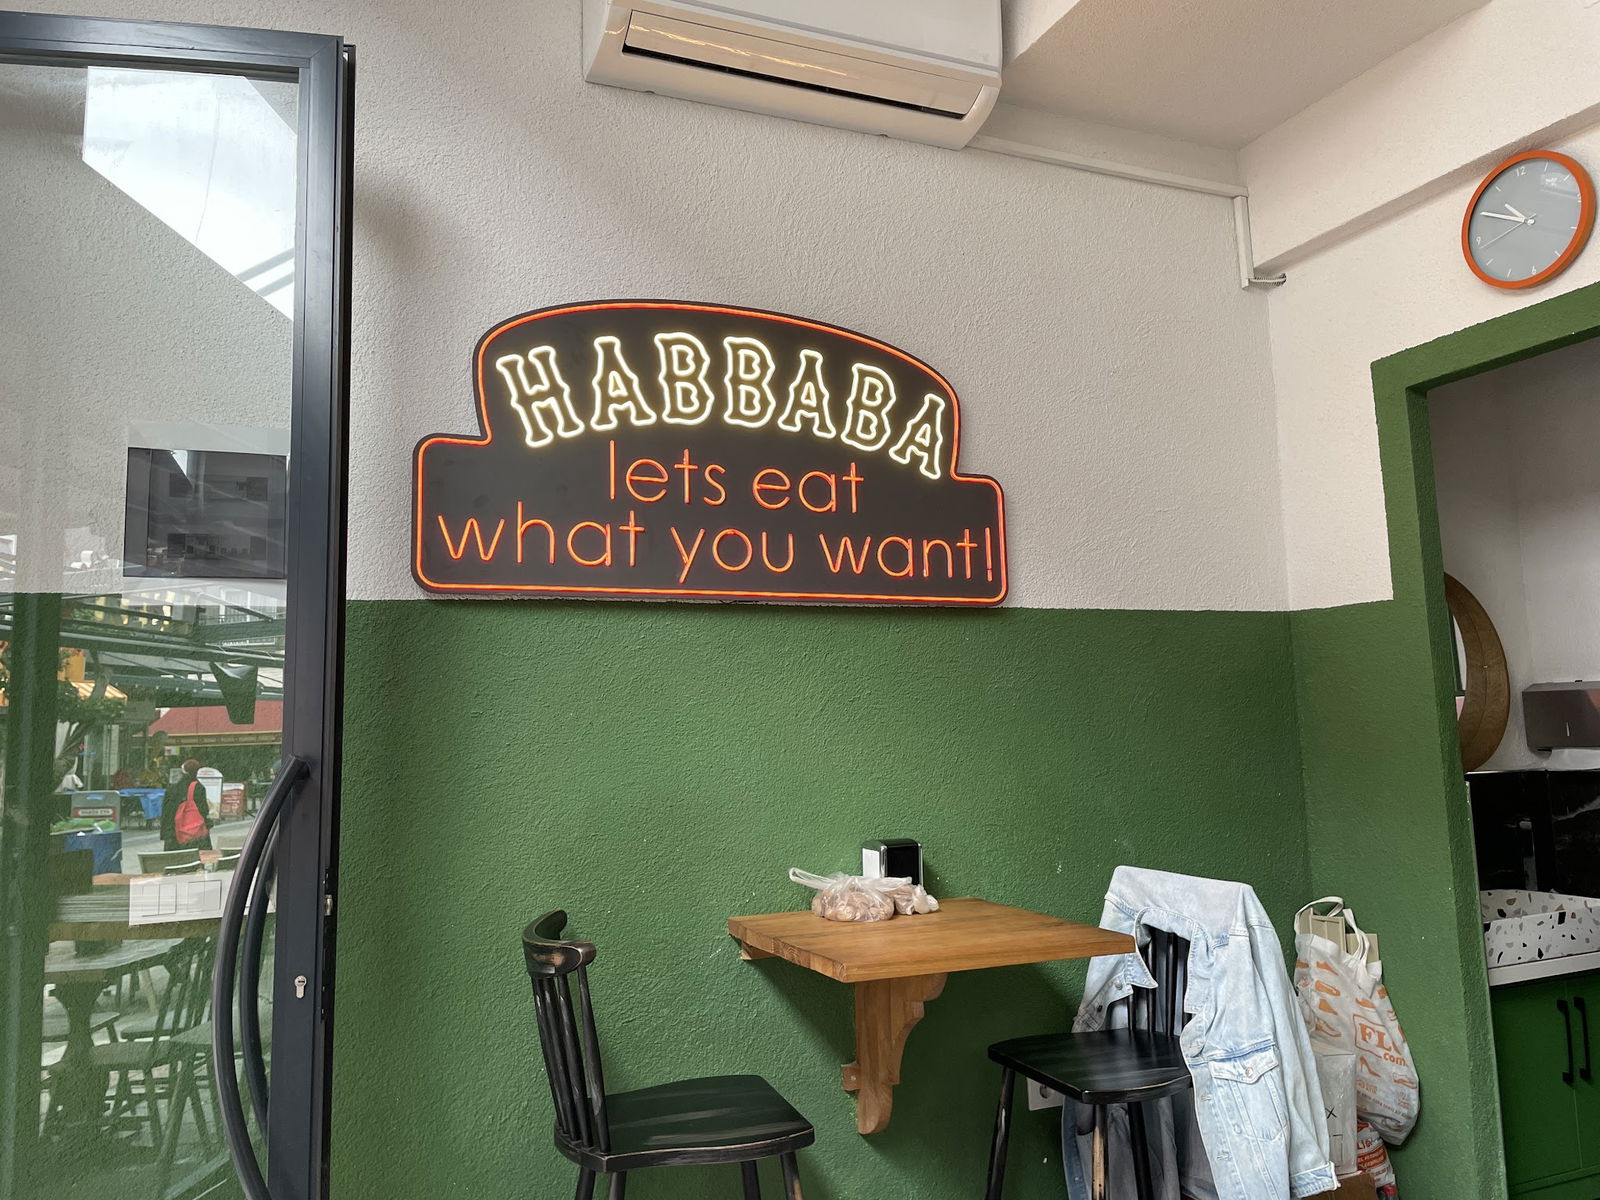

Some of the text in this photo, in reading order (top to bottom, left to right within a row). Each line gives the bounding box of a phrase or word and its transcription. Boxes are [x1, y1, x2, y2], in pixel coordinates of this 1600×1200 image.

[1516, 166, 1527, 177] 12
[1475, 236, 1482, 245] 9
[1531, 265, 1537, 275] 6
[496, 331, 947, 481] HABBABA
[609, 439, 865, 513] lets eat
[437, 501, 993, 584] what you want!
